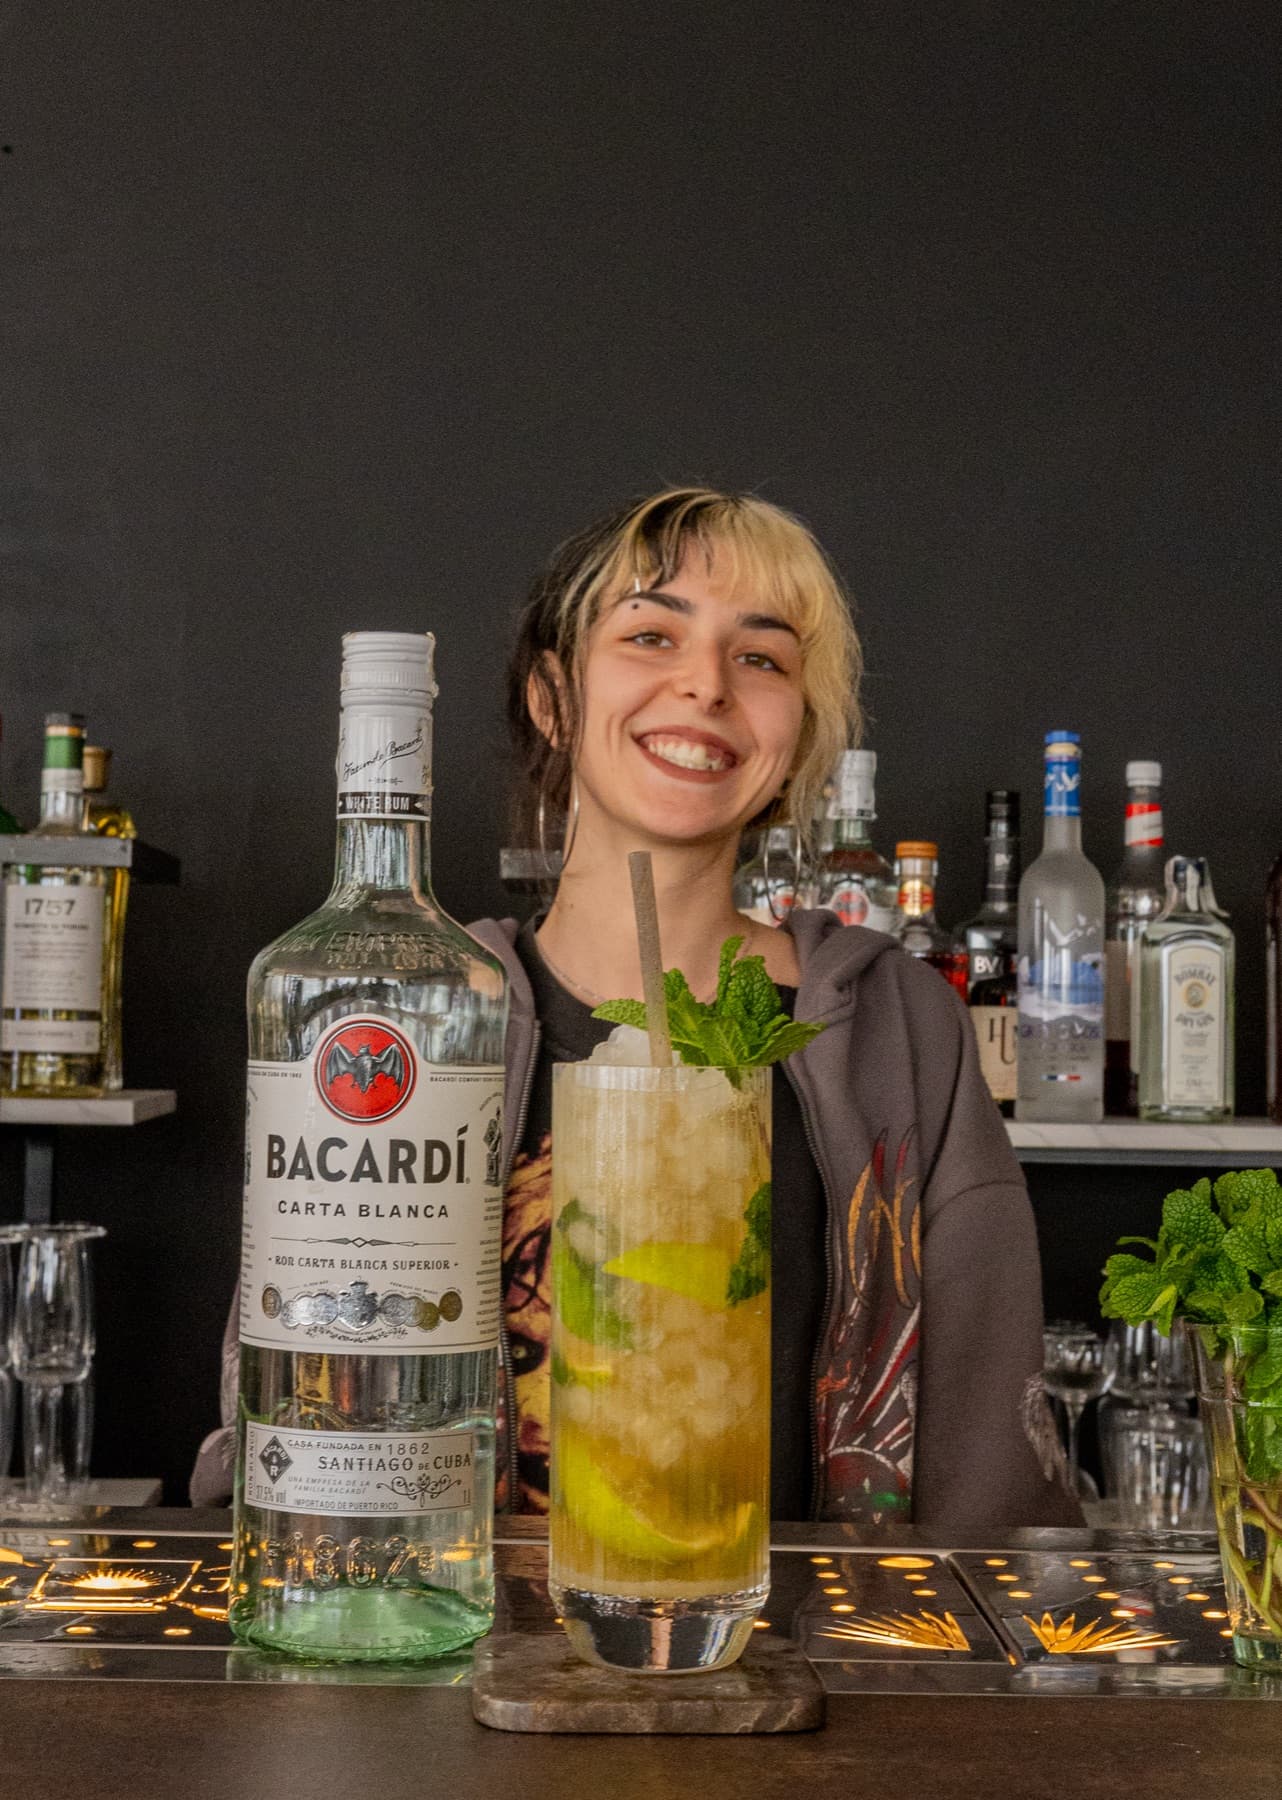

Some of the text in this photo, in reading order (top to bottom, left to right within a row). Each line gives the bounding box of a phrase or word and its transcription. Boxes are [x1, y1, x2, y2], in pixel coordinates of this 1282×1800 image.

[345, 796, 409, 811] WHITE RUM
[24, 898, 76, 916] 1757
[267, 1124, 469, 1184] BACARDÍ
[278, 1200, 449, 1218] CARTA BLANCA
[275, 1255, 450, 1271] RON CARTA BLANCA SUPERIOR
[287, 1440, 313, 1448] CASA
[316, 1441, 365, 1451] FUNDADA
[388, 1443, 430, 1455] 1862
[318, 1456, 413, 1471] SANTIAGO
[433, 1453, 471, 1470] CUBA
[337, 1502, 349, 1510] DE
[349, 1501, 378, 1510] PUERTO
[380, 1502, 399, 1510] RICO
